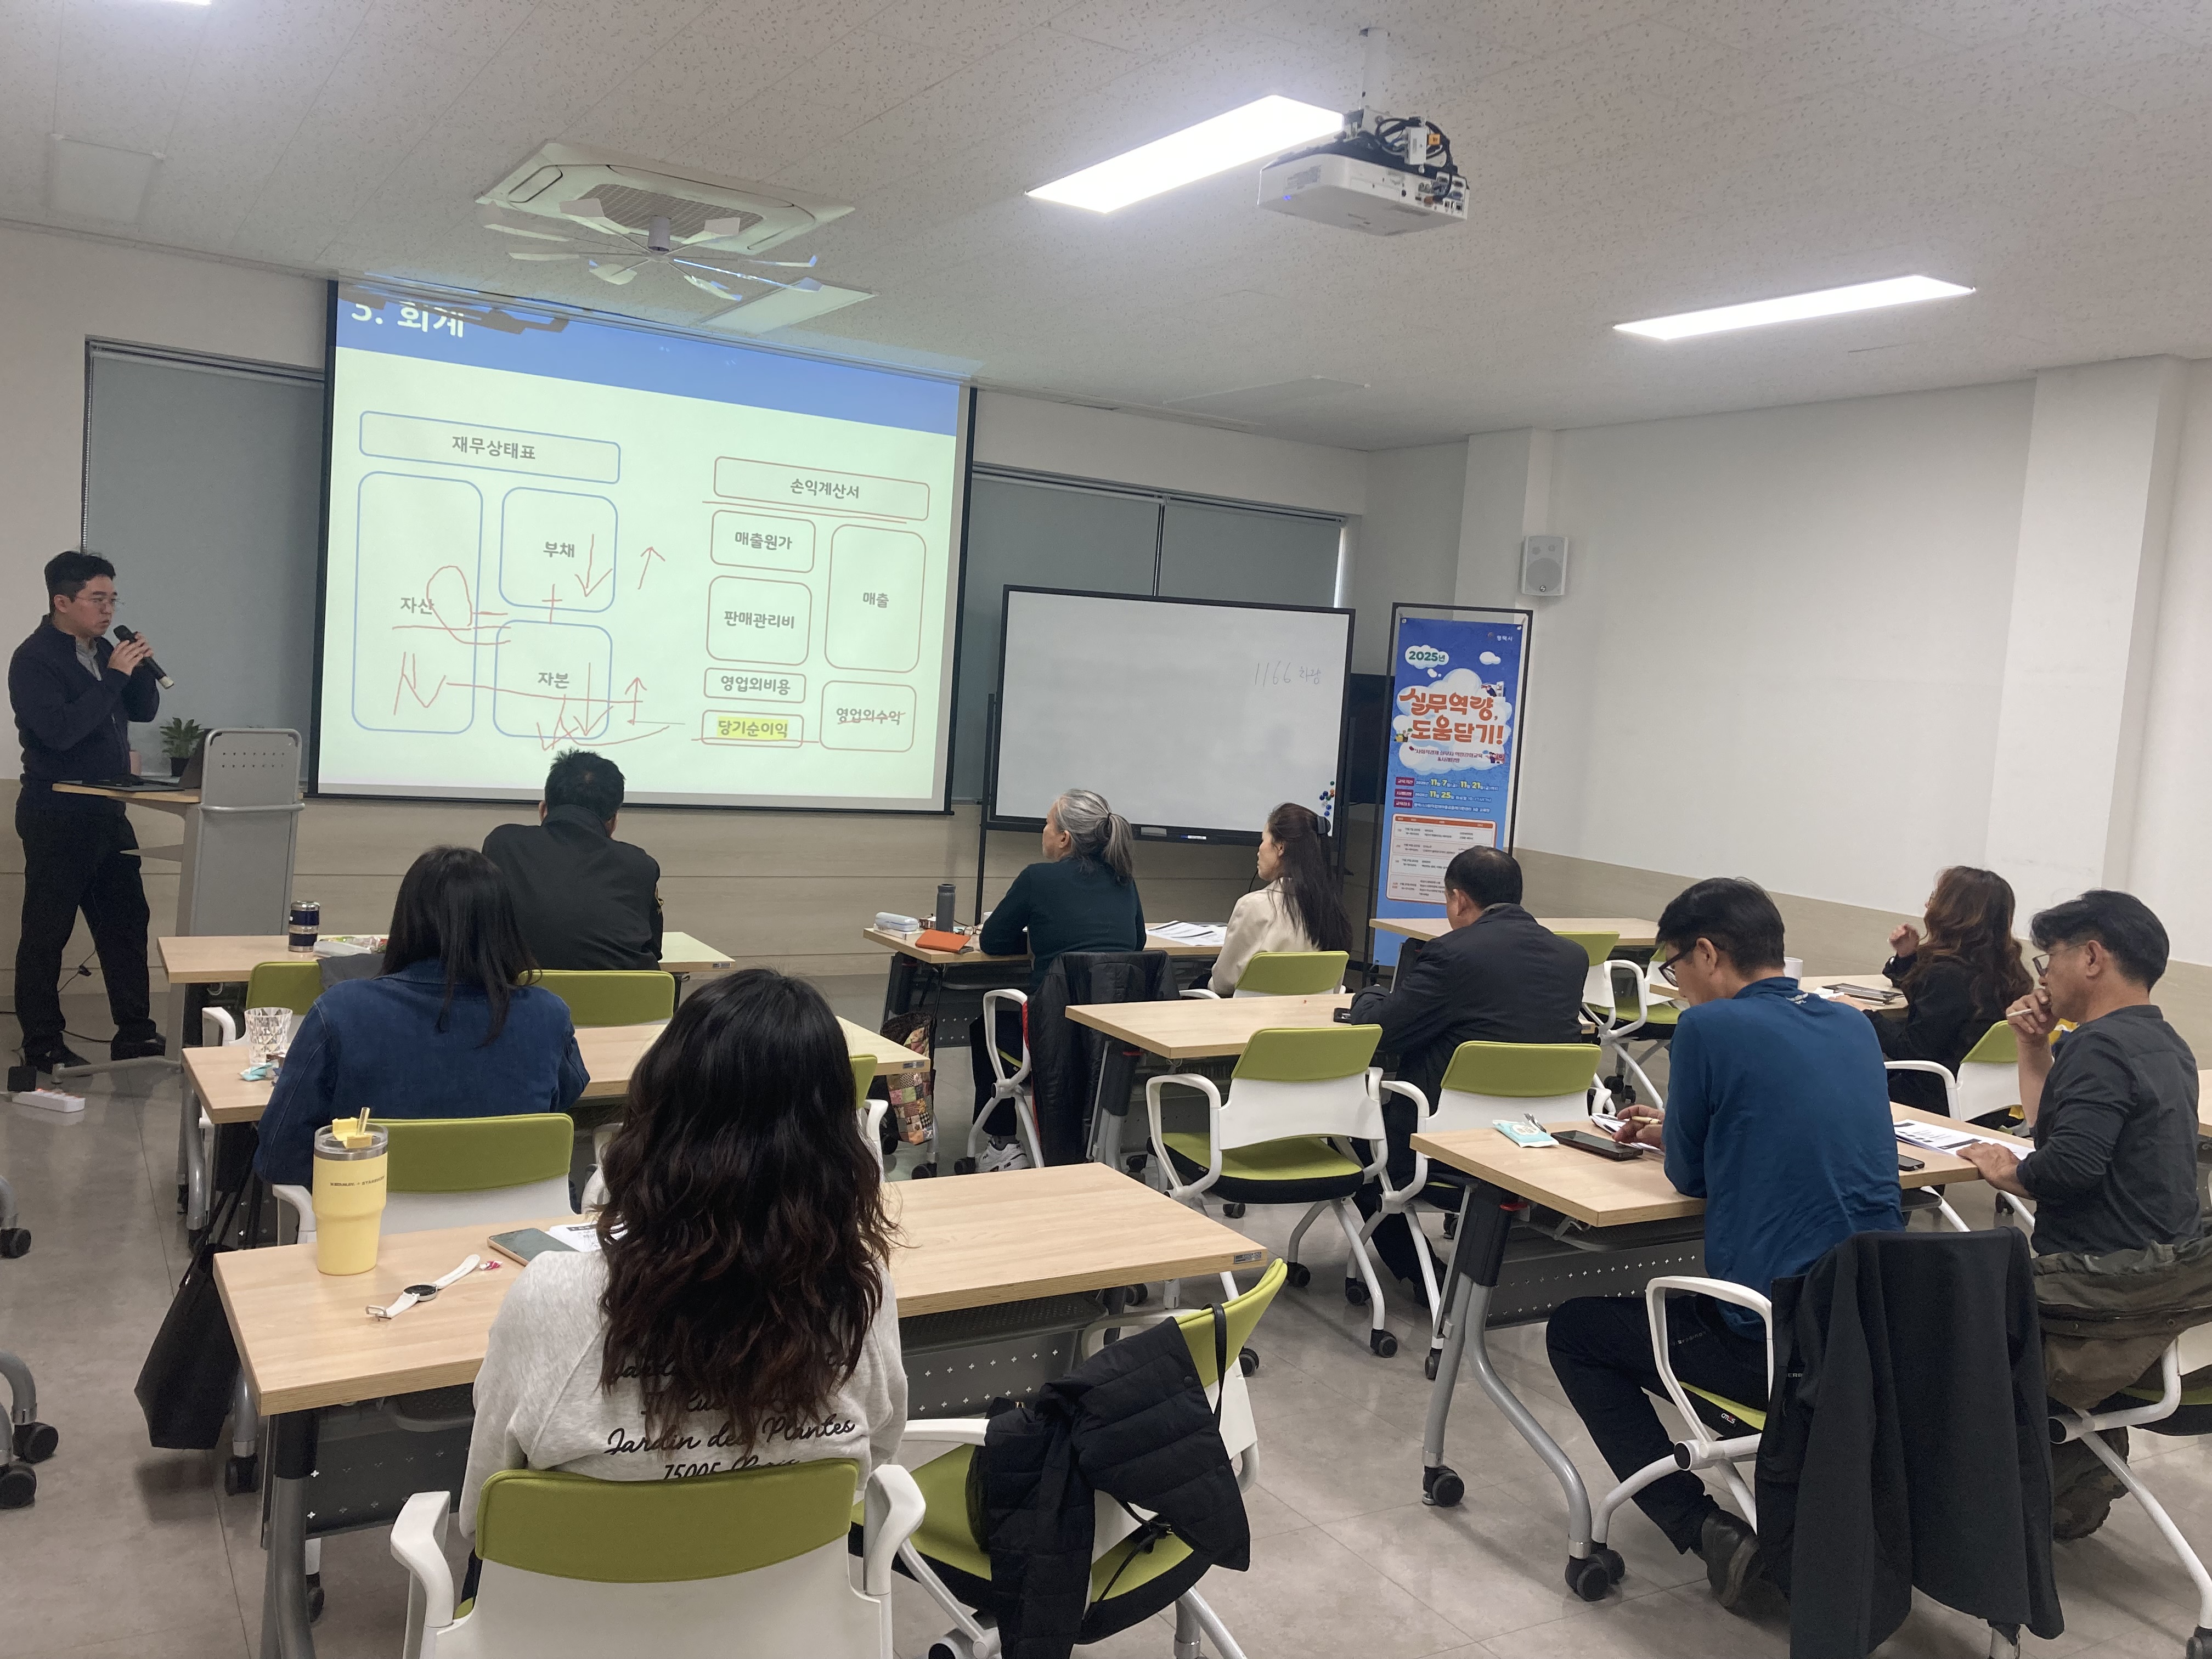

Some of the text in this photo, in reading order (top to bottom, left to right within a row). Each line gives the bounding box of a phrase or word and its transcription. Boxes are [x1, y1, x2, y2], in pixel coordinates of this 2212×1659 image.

[397, 301, 464, 338] 회계
[452, 436, 535, 460] 재무상태표
[791, 478, 859, 499] 손익계산서
[543, 541, 575, 558] 부채
[735, 532, 792, 550] 매출원가
[400, 597, 434, 615] 자산
[863, 592, 888, 608] 매출
[724, 611, 794, 629] 판매관리비
[1409, 651, 1445, 662] 2025년
[538, 672, 569, 689] 자본
[1255, 661, 1291, 686] 1166
[721, 676, 791, 696] 영업외비용
[1399, 688, 1498, 721] 실무역량,
[836, 708, 901, 725] 영업외수익
[719, 720, 788, 738] 당기순이익
[1411, 714, 1504, 745] 도움닫기!
[604, 1425, 701, 1455] Jardin
[762, 1413, 855, 1443] Plantes
